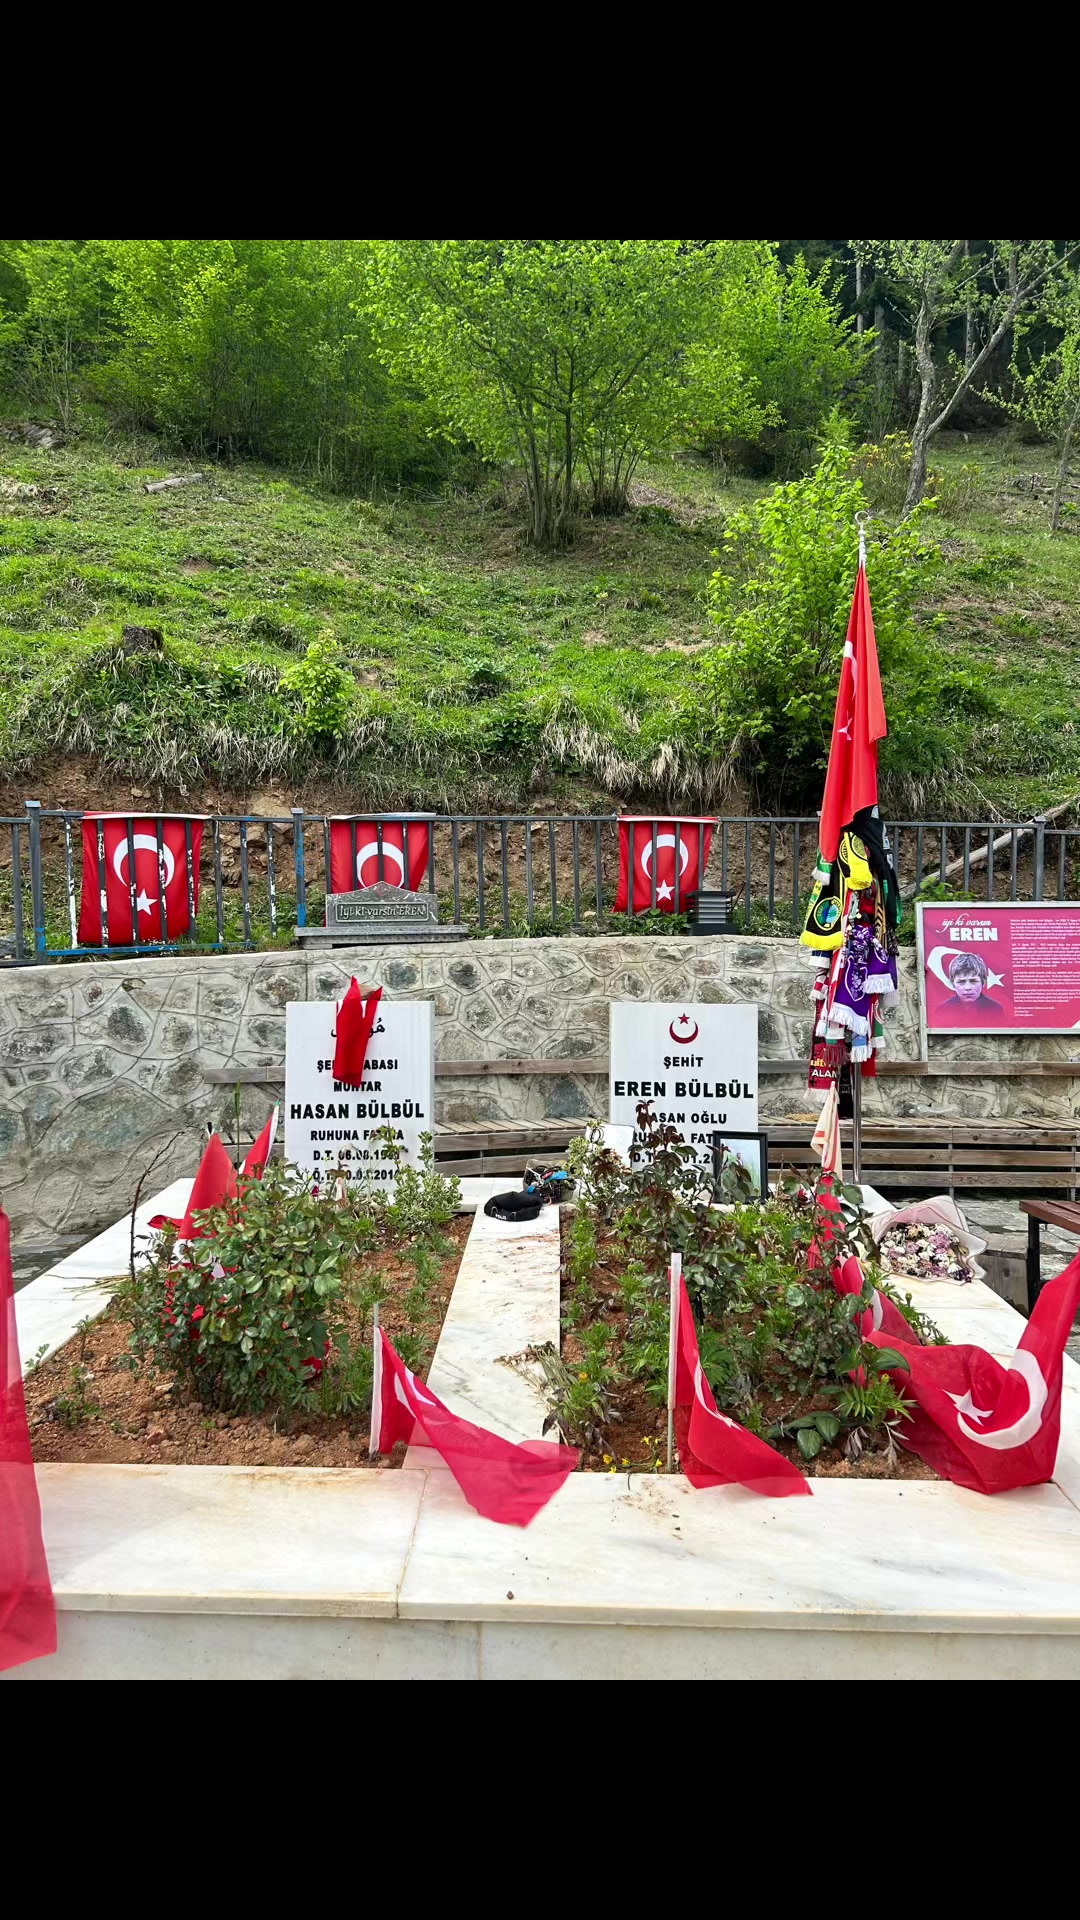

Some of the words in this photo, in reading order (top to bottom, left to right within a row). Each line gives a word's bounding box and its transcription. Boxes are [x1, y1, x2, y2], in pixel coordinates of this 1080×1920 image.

[399, 905, 425, 916] EREN
[950, 928, 998, 941] EREN
[364, 1060, 398, 1070] ABASI
[664, 1054, 703, 1069] ŞEHİT
[614, 1081, 666, 1096] EREN
[675, 1079, 754, 1098] BÜLBÜL
[291, 1104, 350, 1119] HASAN
[356, 1099, 425, 1119] BÜLBÜL
[651, 1113, 685, 1124] ASAN
[691, 1110, 727, 1124] OĞLU
[310, 1130, 359, 1141] RUHUNA
[313, 1150, 334, 1160] D.T.
[338, 1149, 400, 1160] 06.08.19
[633, 1153, 653, 1163] D.T
